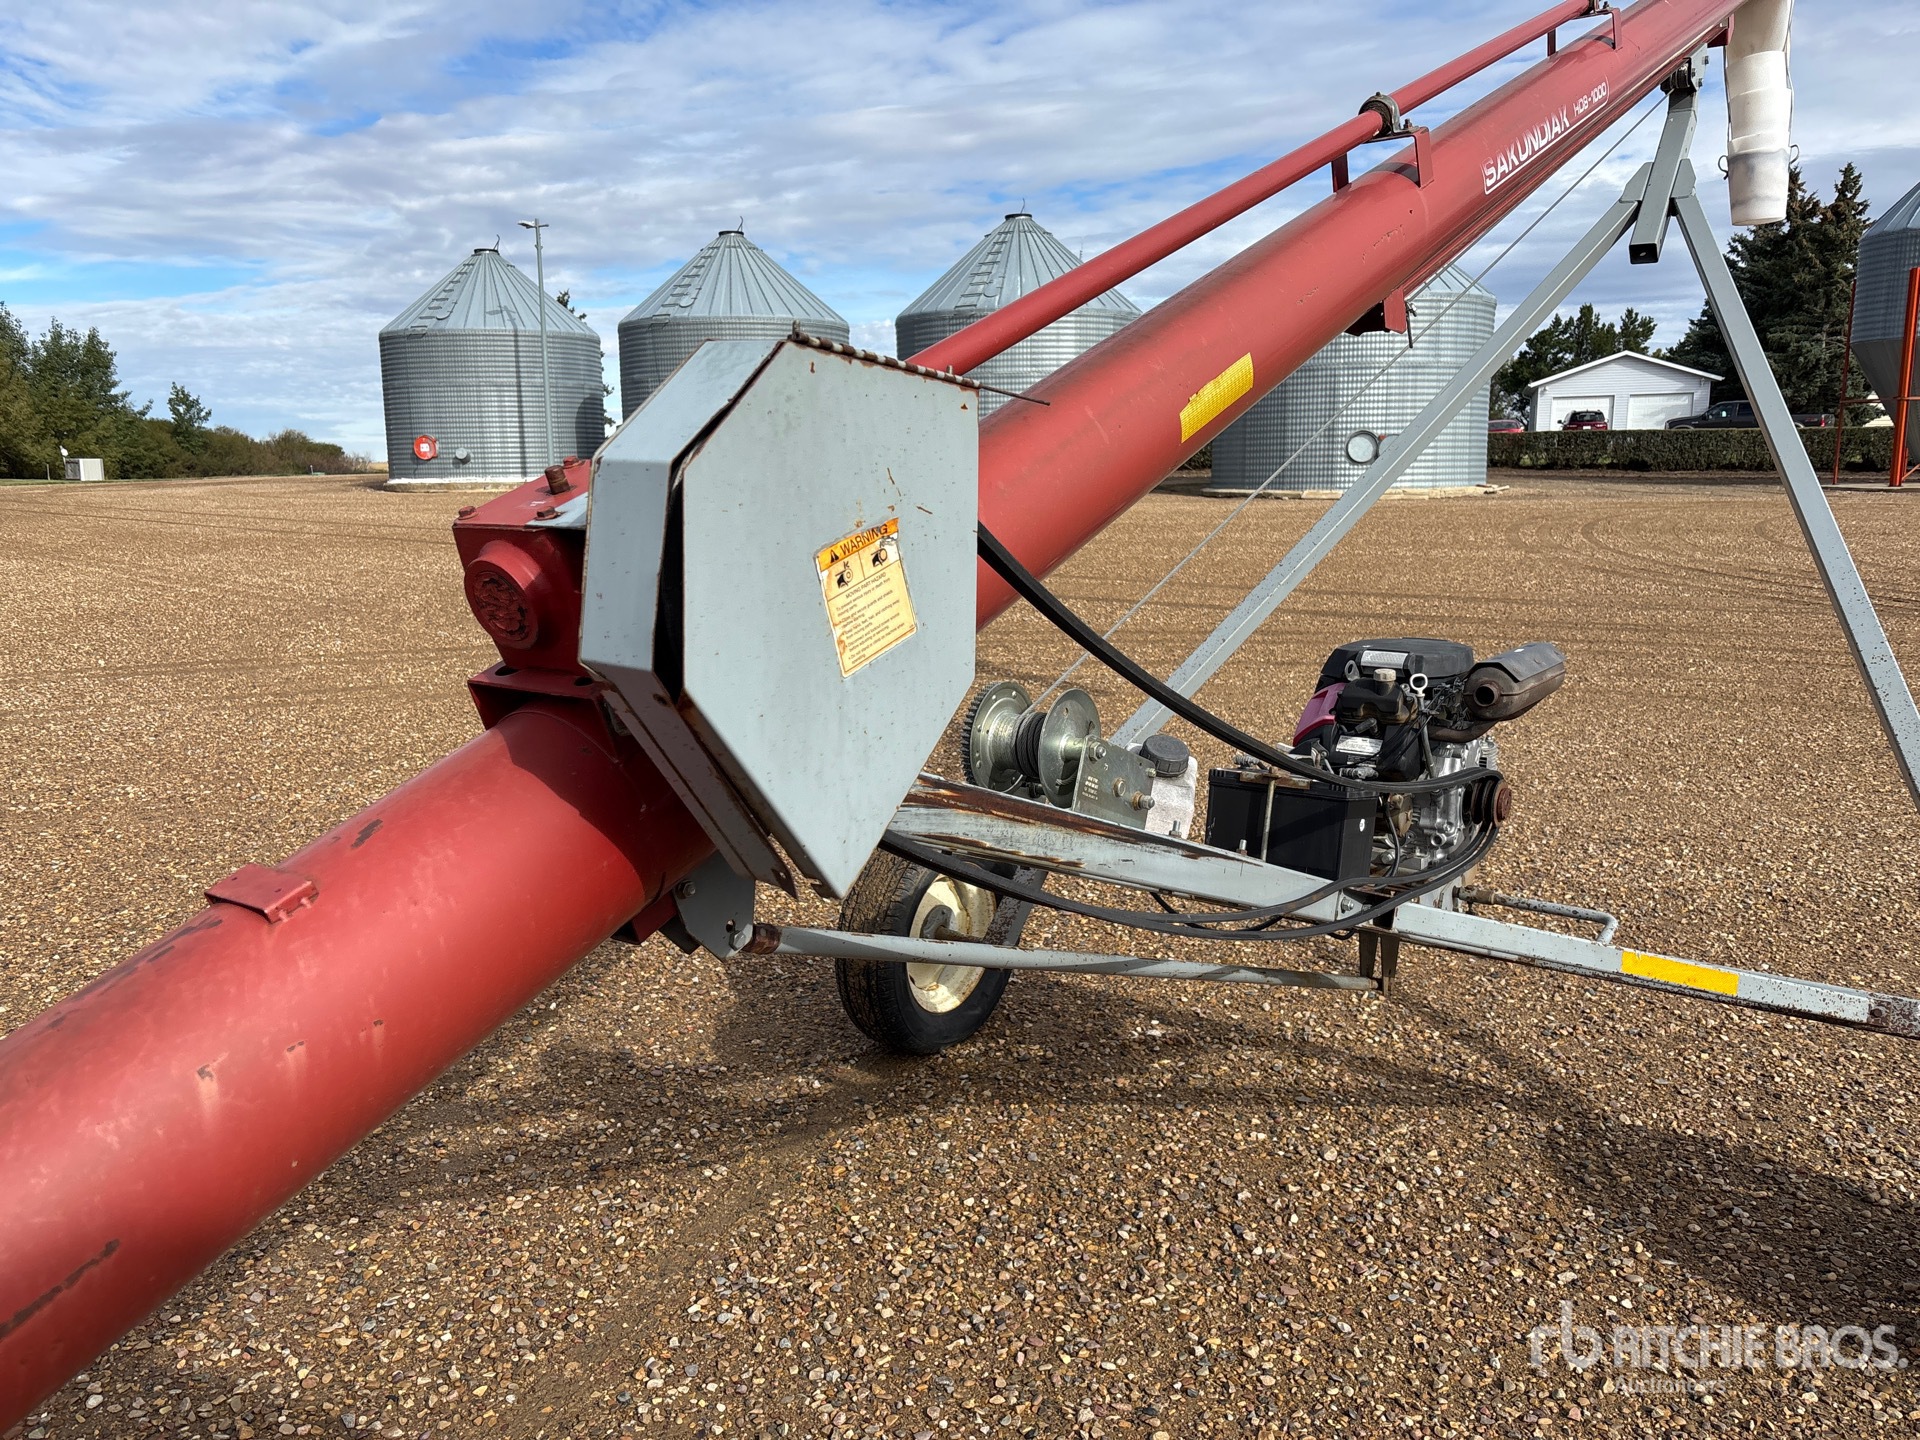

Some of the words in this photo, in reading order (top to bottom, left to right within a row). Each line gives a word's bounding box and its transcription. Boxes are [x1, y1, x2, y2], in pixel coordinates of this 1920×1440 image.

[1482, 104, 1570, 187] SAKUNDIAK
[840, 523, 888, 556] WARNING
[845, 587, 861, 599] MOVING
[871, 572, 886, 584] HAZARD
